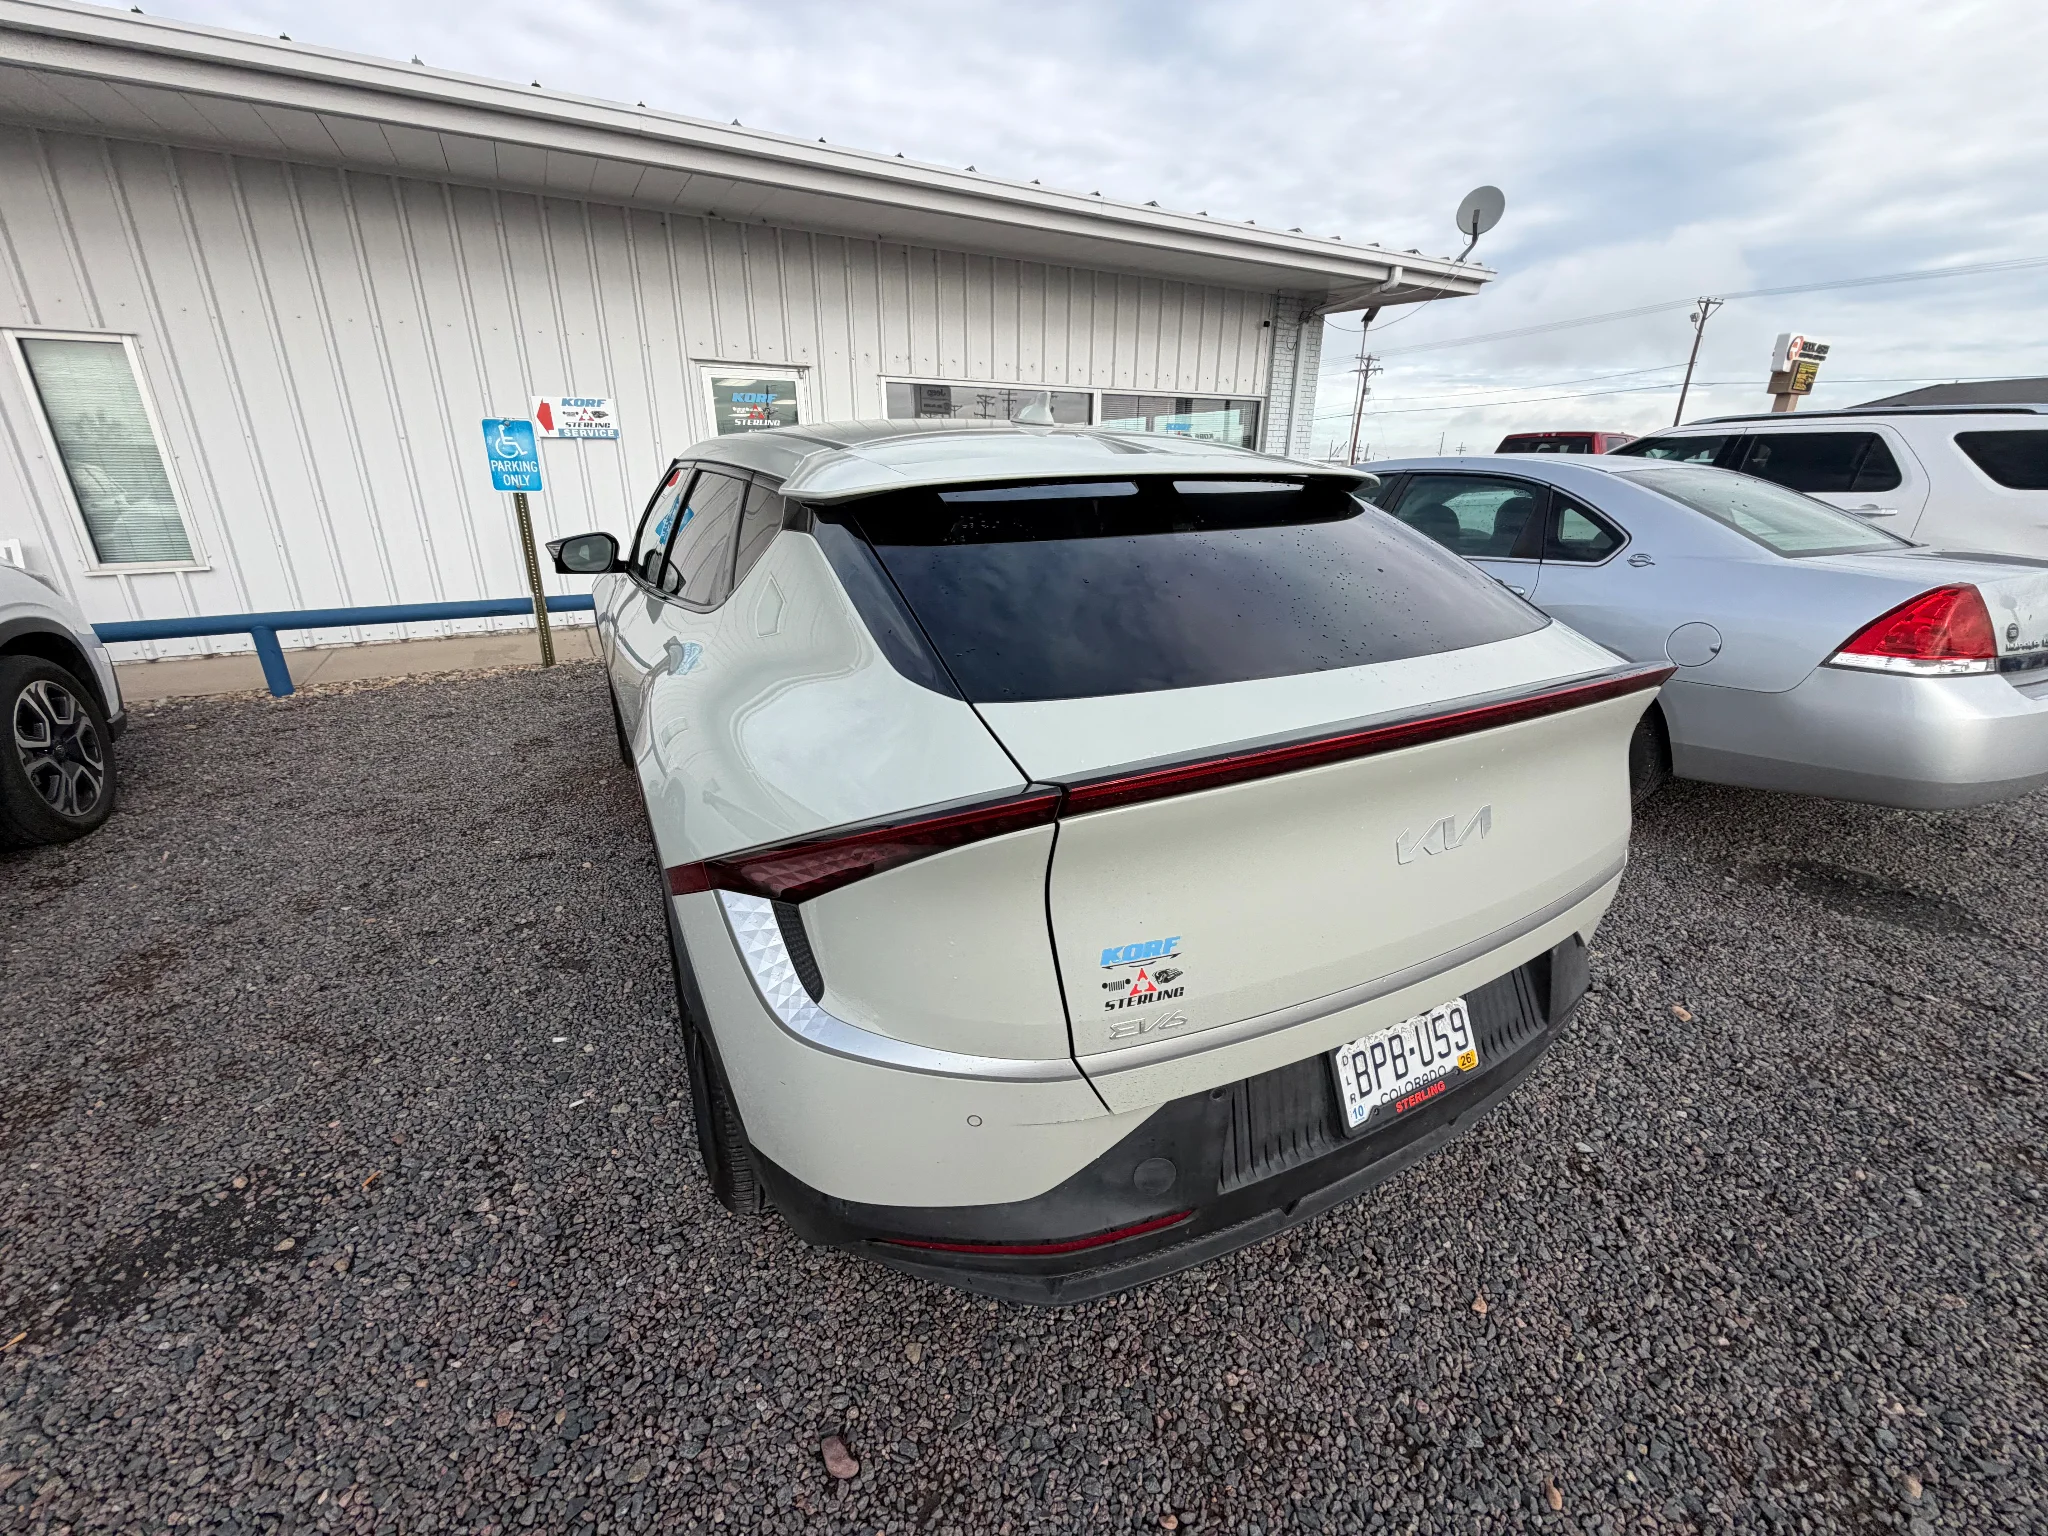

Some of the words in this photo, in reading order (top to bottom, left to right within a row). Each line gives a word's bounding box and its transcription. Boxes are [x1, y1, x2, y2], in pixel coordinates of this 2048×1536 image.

[561, 397, 607, 408] KORF
[732, 392, 778, 403] KORF
[565, 421, 611, 429] STERLING
[734, 419, 781, 427] STERLING
[563, 428, 615, 437] SERVICE
[490, 460, 538, 473] PARKING
[503, 474, 531, 486] ONLY
[1100, 935, 1182, 966] KORF
[1104, 986, 1185, 1012] STERLING
[1109, 1009, 1189, 1040] EV6
[1460, 1053, 1472, 1067] 26
[1380, 1064, 1447, 1105] COLORADO
[1395, 1080, 1446, 1114] STERLING
[1352, 1104, 1365, 1120] 10
